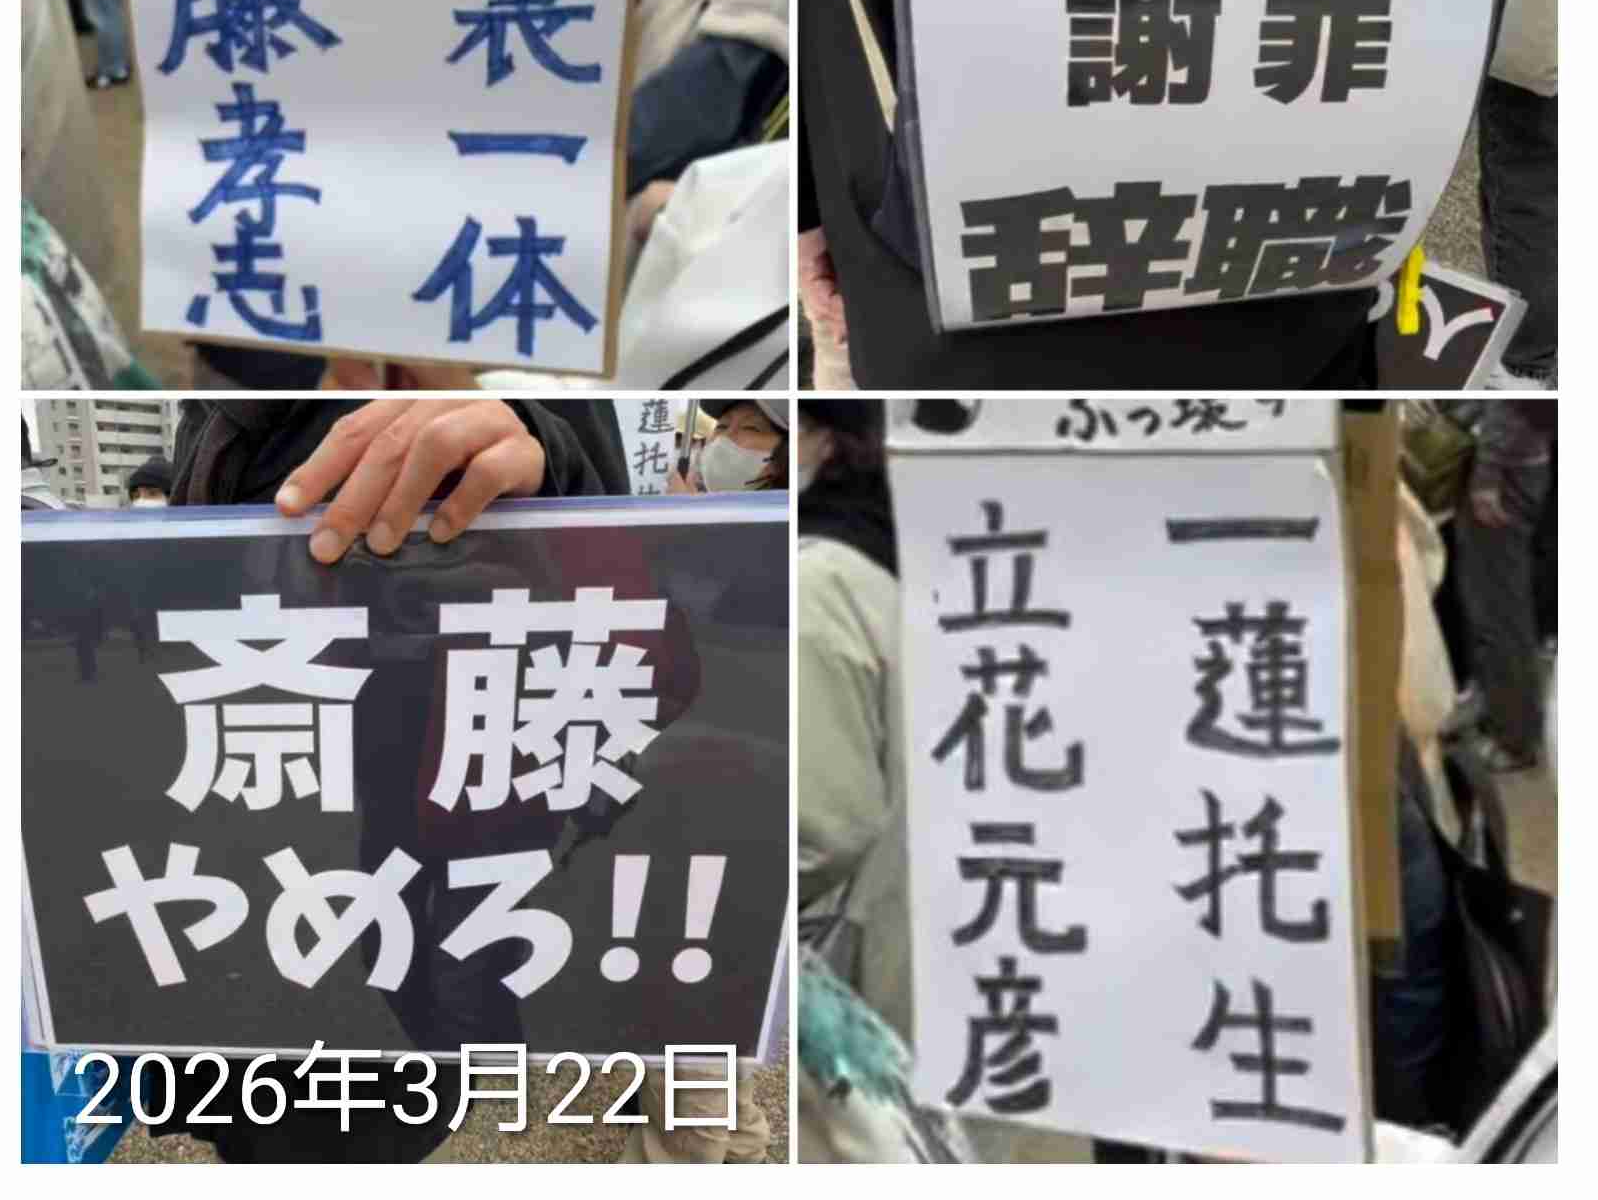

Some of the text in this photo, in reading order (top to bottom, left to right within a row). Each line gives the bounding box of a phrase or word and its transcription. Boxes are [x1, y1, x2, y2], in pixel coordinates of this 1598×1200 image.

[960, 174, 1412, 325] 辞職
[157, 586, 668, 815] 斎藤
[931, 500, 1088, 1114] 立花元彦
[83, 842, 728, 1000] やめろ!!
[1165, 517, 1347, 1135] 一蓮托生
